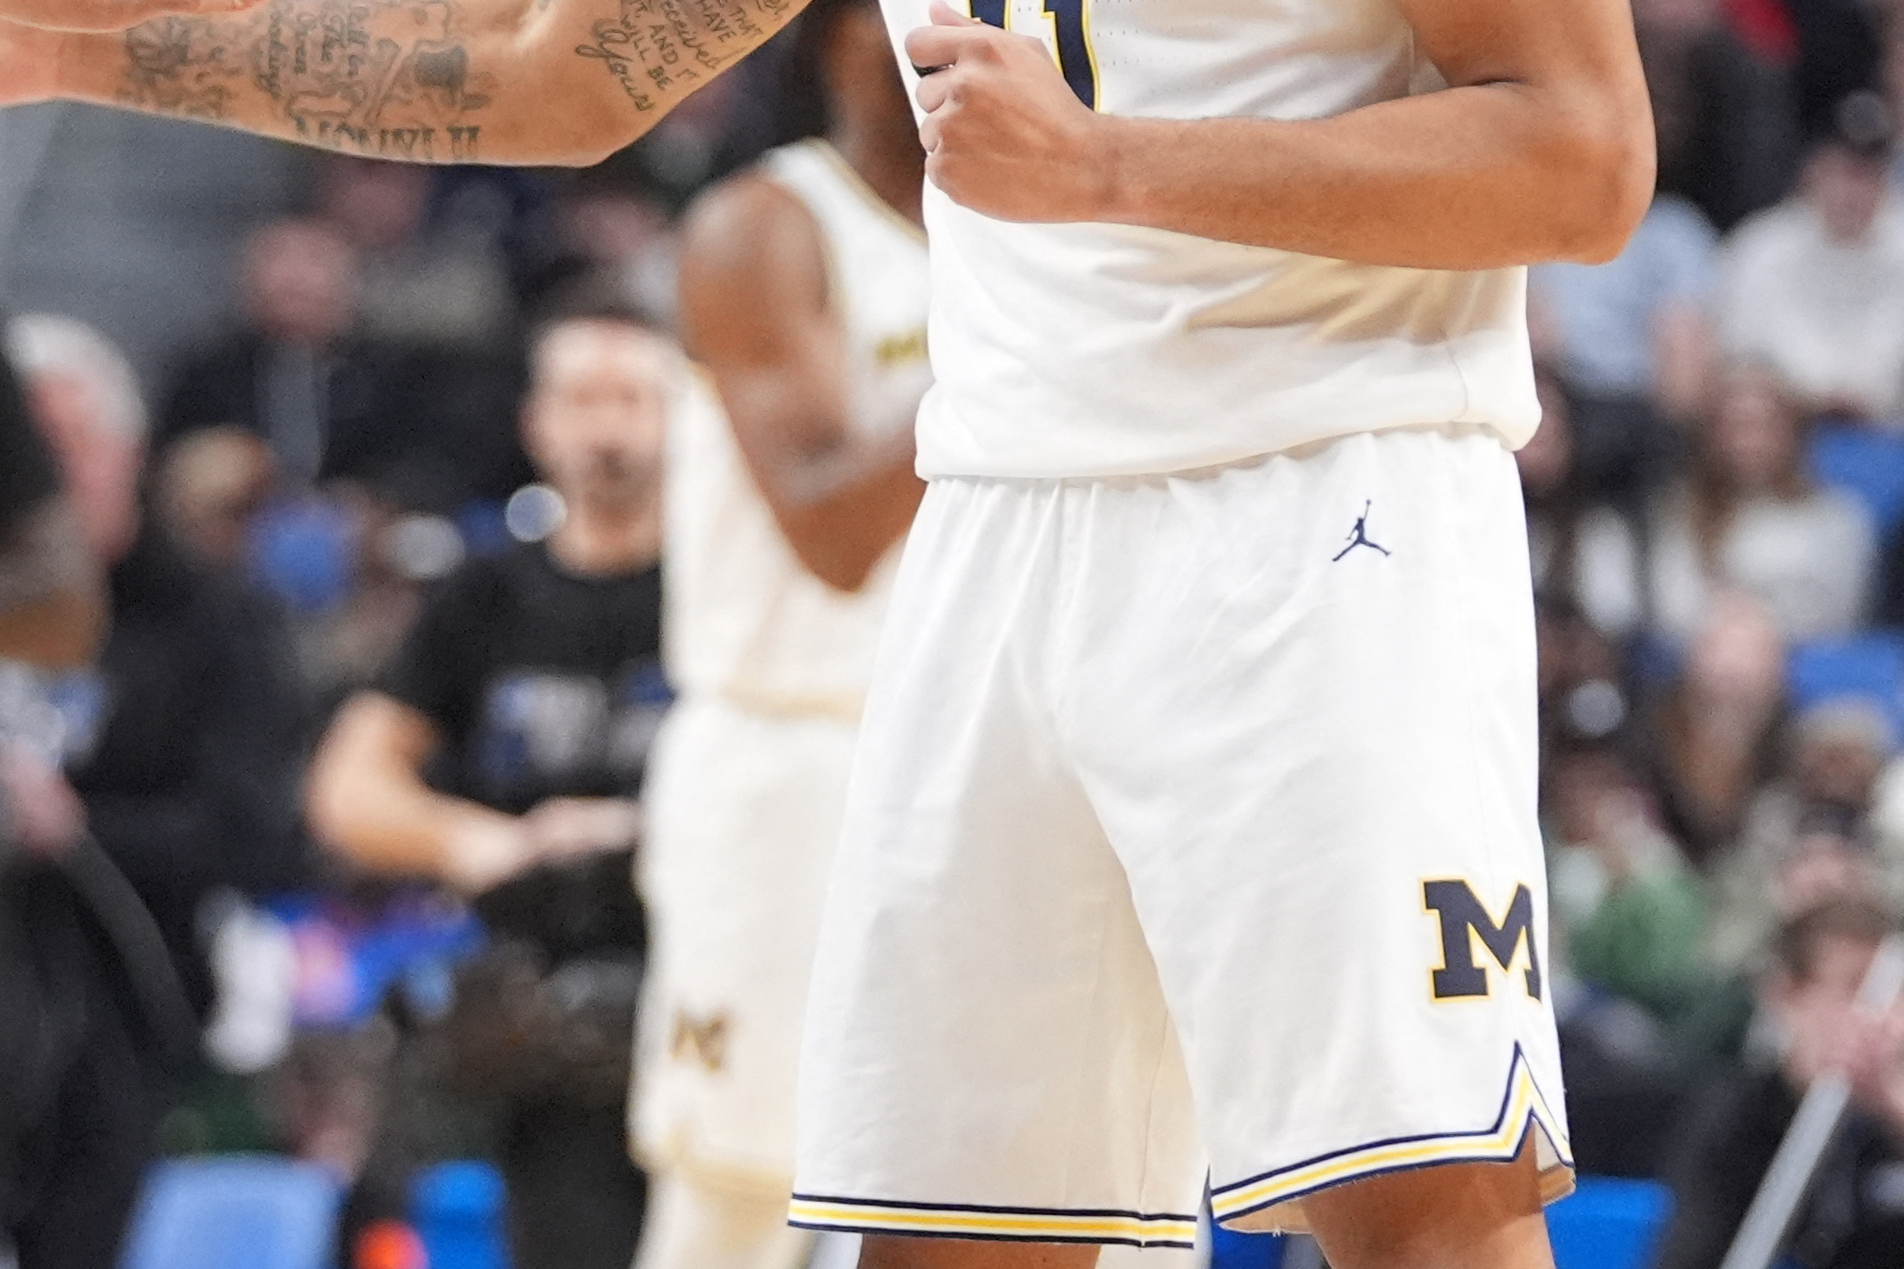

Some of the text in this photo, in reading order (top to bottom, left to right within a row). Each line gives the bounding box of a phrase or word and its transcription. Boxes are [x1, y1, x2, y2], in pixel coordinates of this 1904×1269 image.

[730, 6, 764, 39] THAT
[648, 24, 679, 65] AND
[647, 66, 673, 91] BE
[1419, 878, 1542, 1005] M
